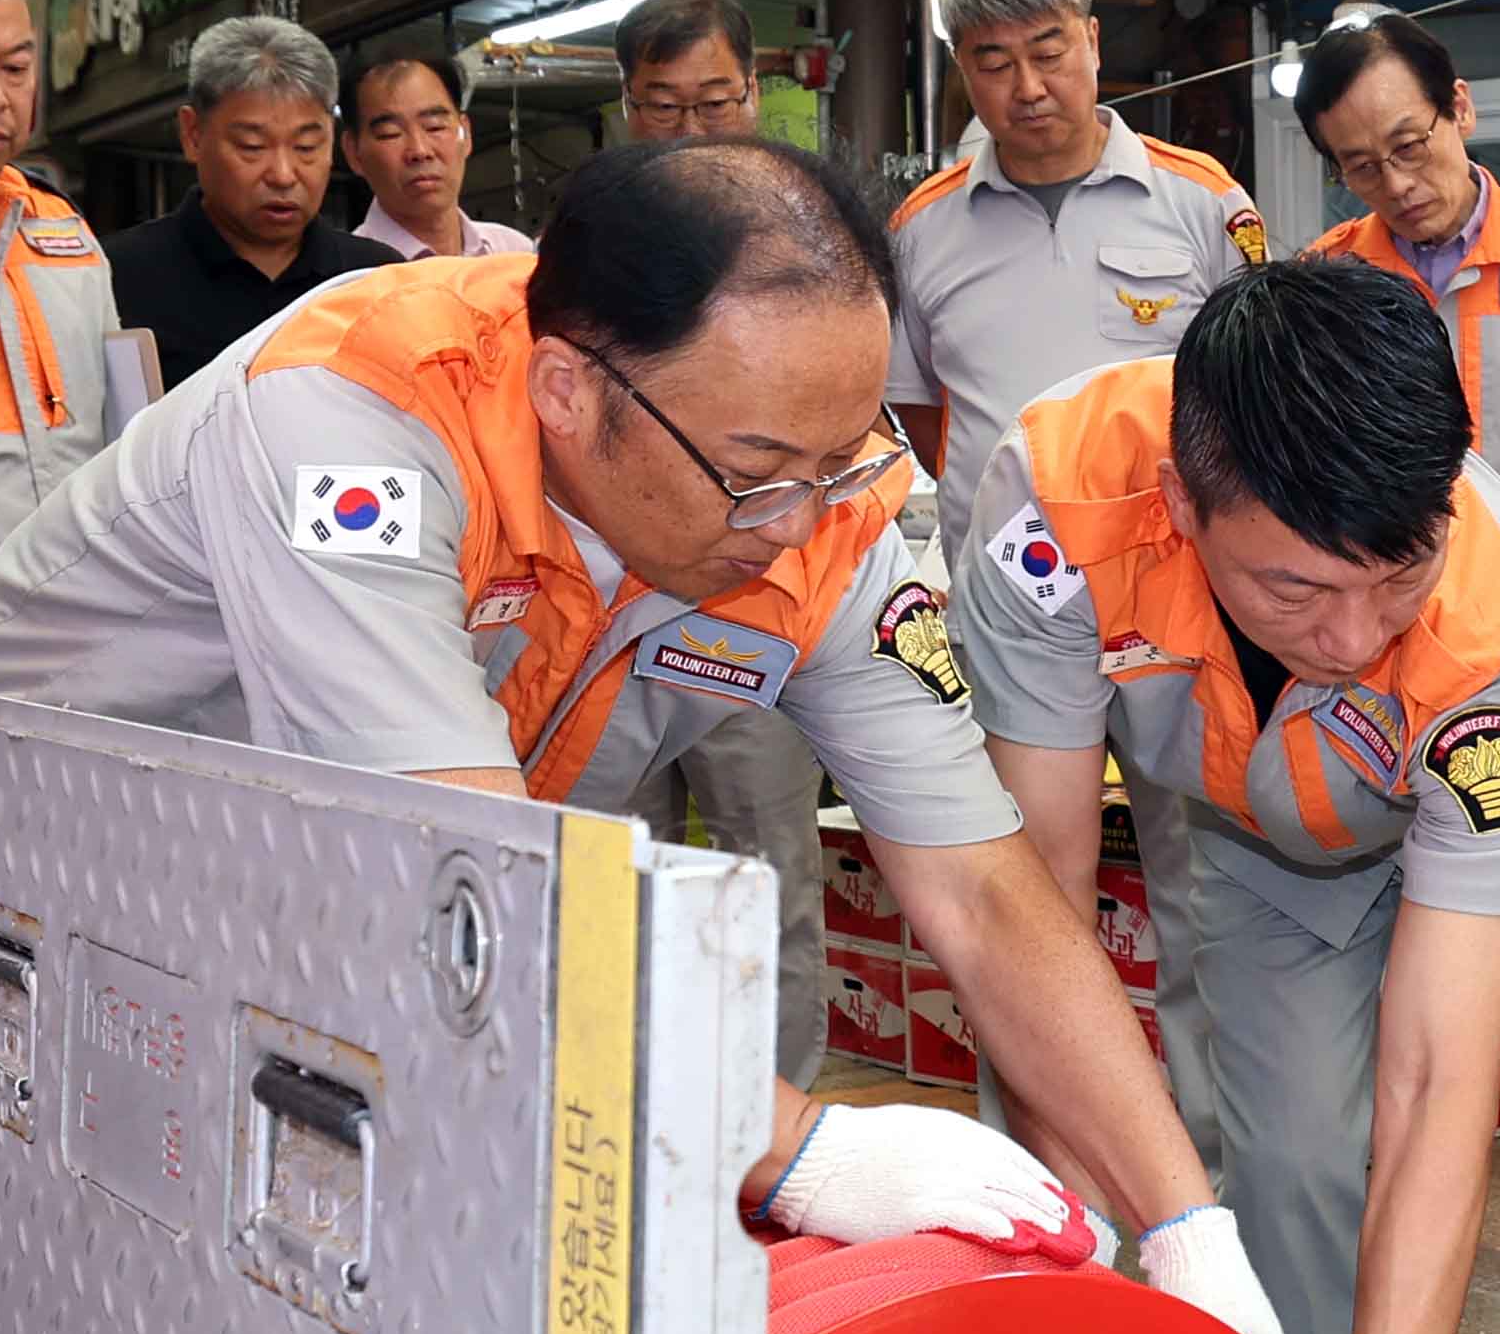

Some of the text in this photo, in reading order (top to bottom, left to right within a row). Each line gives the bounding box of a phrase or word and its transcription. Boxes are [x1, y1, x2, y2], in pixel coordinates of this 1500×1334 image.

[660, 650, 762, 689] VOLUNTEER FIRE
[1337, 703, 1396, 769] VOLUNTEER FIRE
[1438, 716, 1495, 749] VOLUNTEER
[559, 1095, 596, 1330] 있습니다
